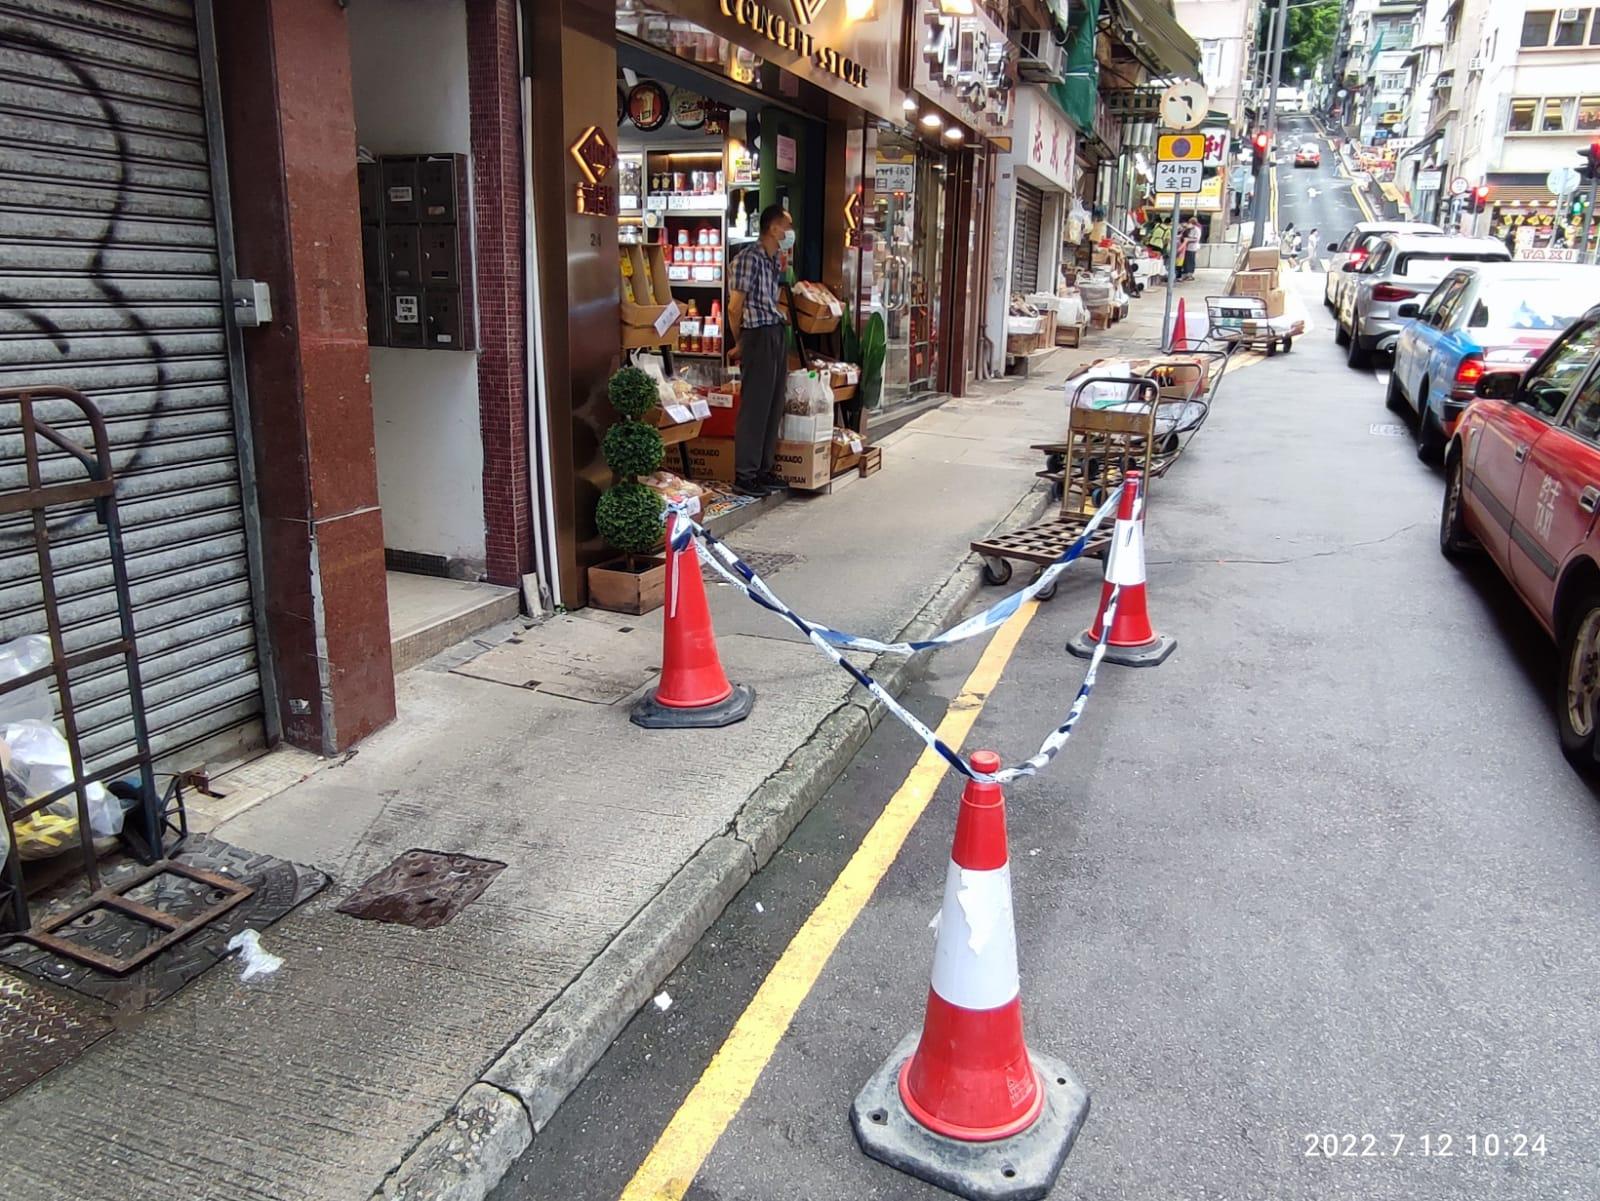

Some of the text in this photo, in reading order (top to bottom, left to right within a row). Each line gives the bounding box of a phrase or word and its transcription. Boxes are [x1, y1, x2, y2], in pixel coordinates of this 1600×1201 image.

[814, 47, 868, 89] STORE
[1161, 164, 1198, 174] 24 hrs
[1165, 176, 1192, 189] 全日
[1520, 249, 1573, 260] TAXI
[1534, 501, 1555, 541] TAXI
